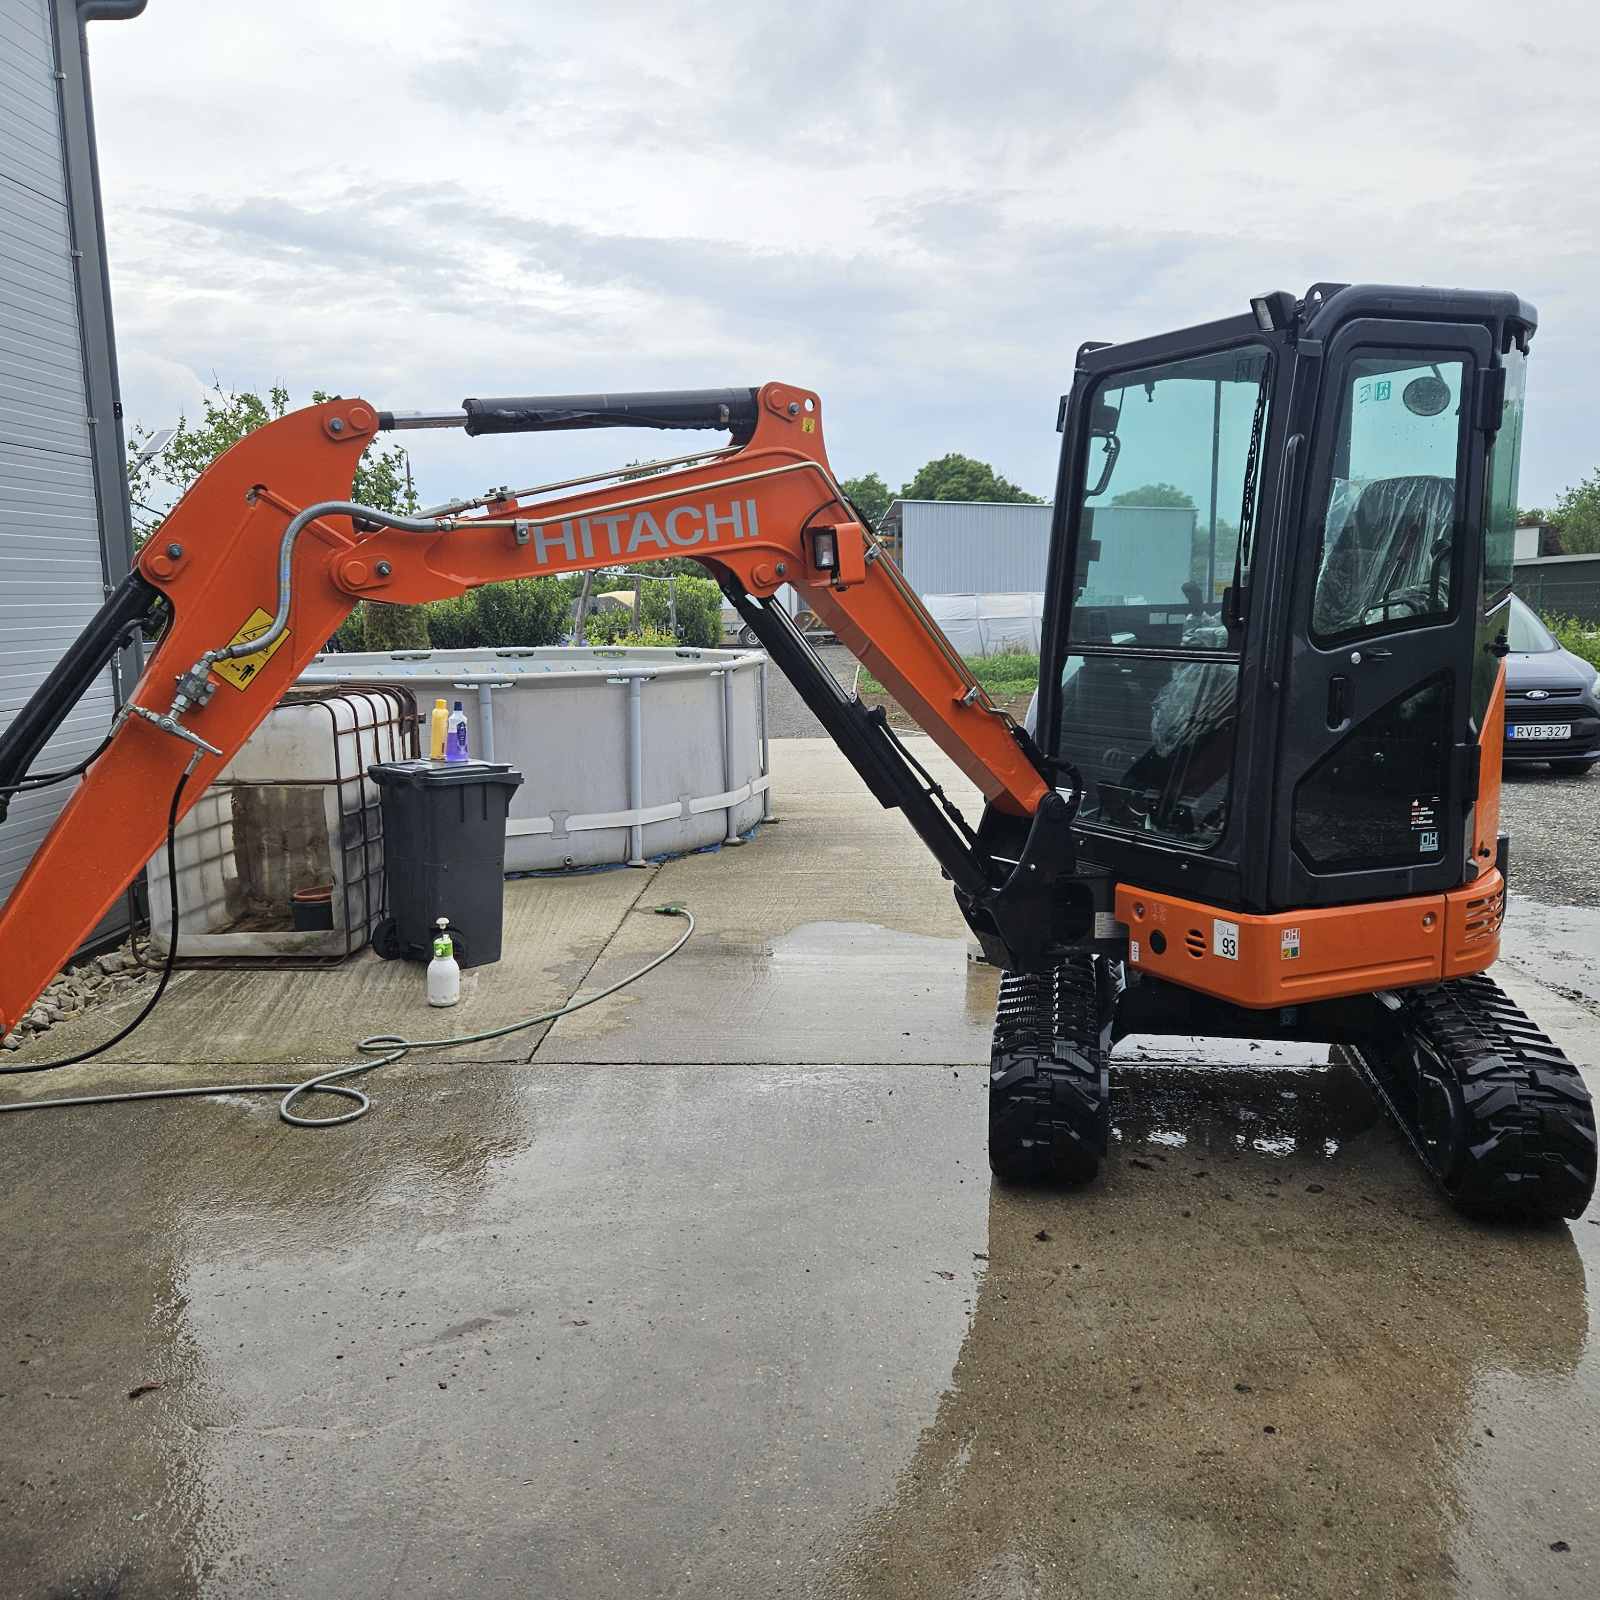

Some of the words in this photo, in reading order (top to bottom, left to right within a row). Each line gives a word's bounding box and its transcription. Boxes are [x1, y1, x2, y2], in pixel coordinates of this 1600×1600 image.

[533, 499, 760, 565] HITACHI
[1517, 726, 1569, 737] RVB-327
[1222, 937, 1236, 956] 93
